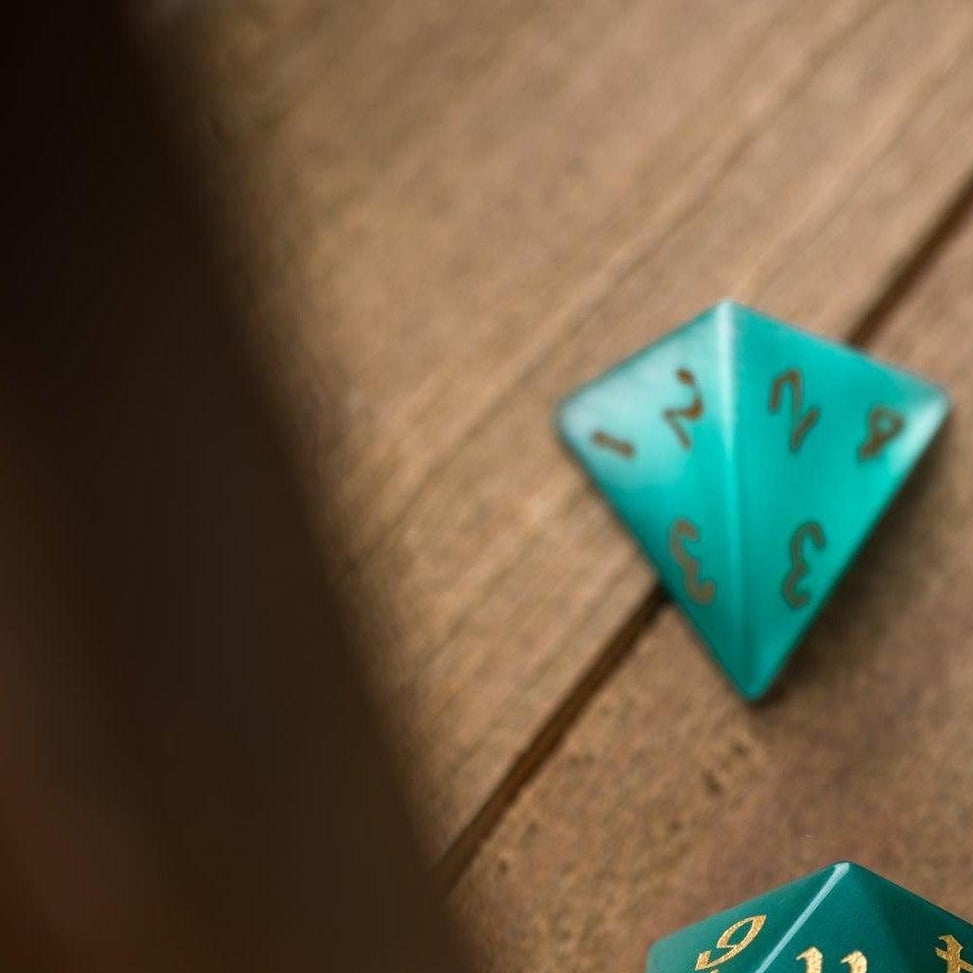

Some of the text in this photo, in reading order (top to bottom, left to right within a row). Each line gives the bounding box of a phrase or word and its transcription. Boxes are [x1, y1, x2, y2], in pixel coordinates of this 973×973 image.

[663, 369, 705, 450] 2
[769, 370, 819, 454] 2
[670, 519, 715, 605] 3
[782, 522, 825, 607] 3
